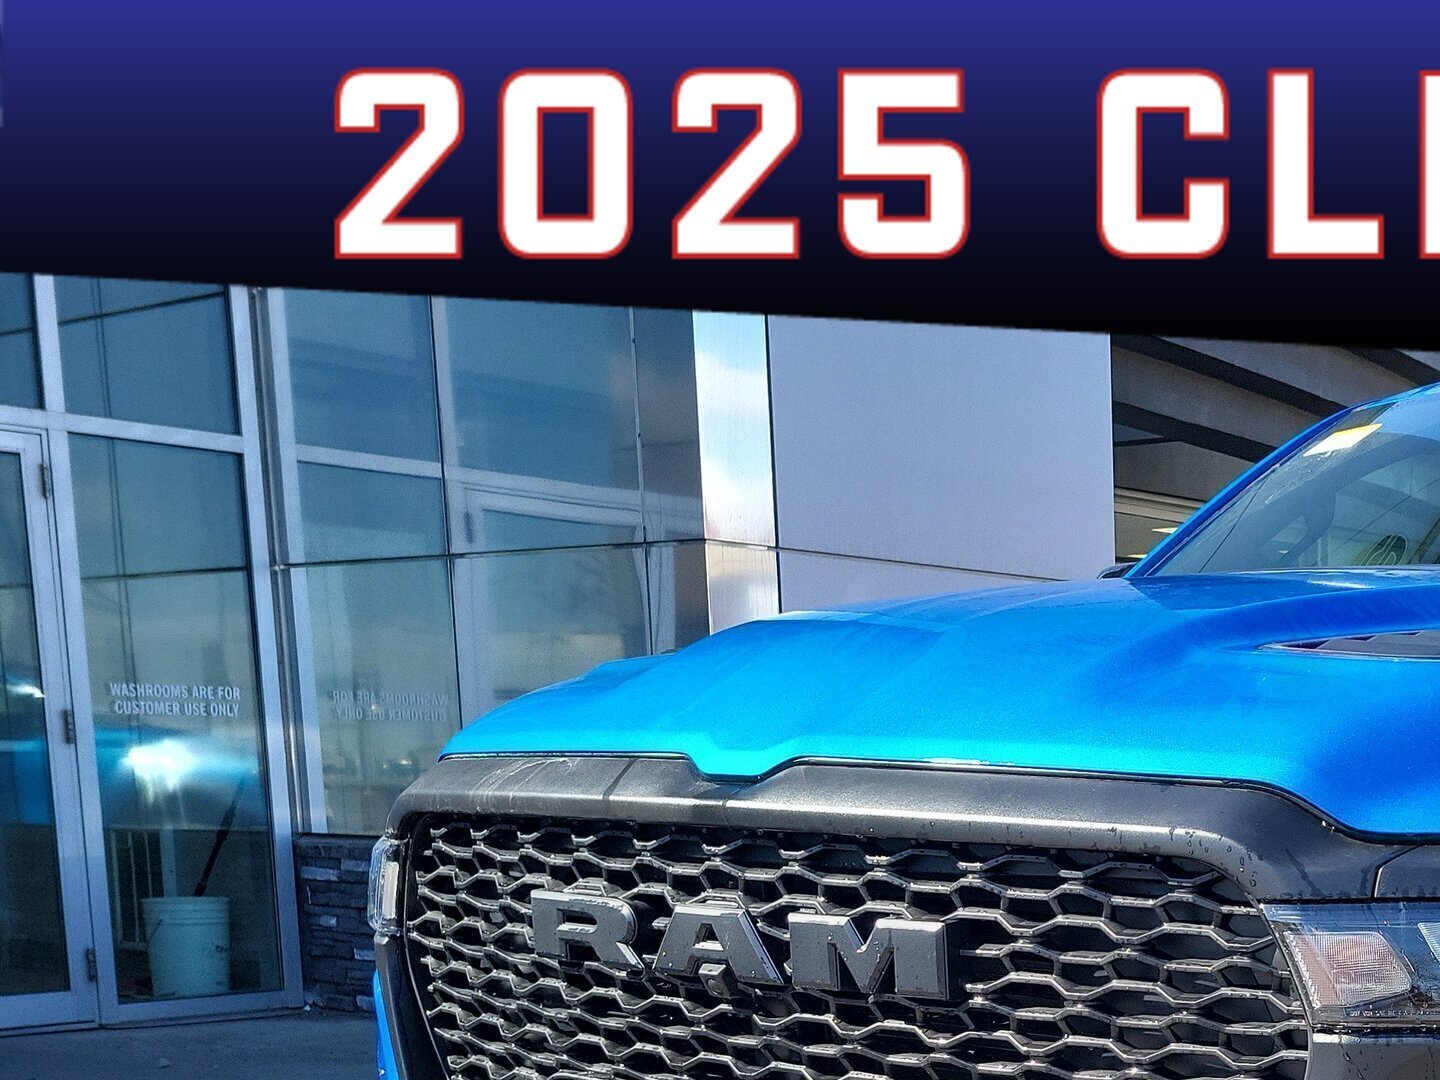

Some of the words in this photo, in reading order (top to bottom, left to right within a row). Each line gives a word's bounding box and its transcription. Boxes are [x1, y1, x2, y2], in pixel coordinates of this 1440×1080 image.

[110, 683, 189, 699] WASHROOMS
[192, 686, 215, 700] ARE
[218, 687, 240, 701] FOR
[114, 700, 180, 715] CUSTOMER
[184, 702, 208, 716] USE
[210, 703, 239, 717] ONLY
[530, 890, 949, 1000] RAM
